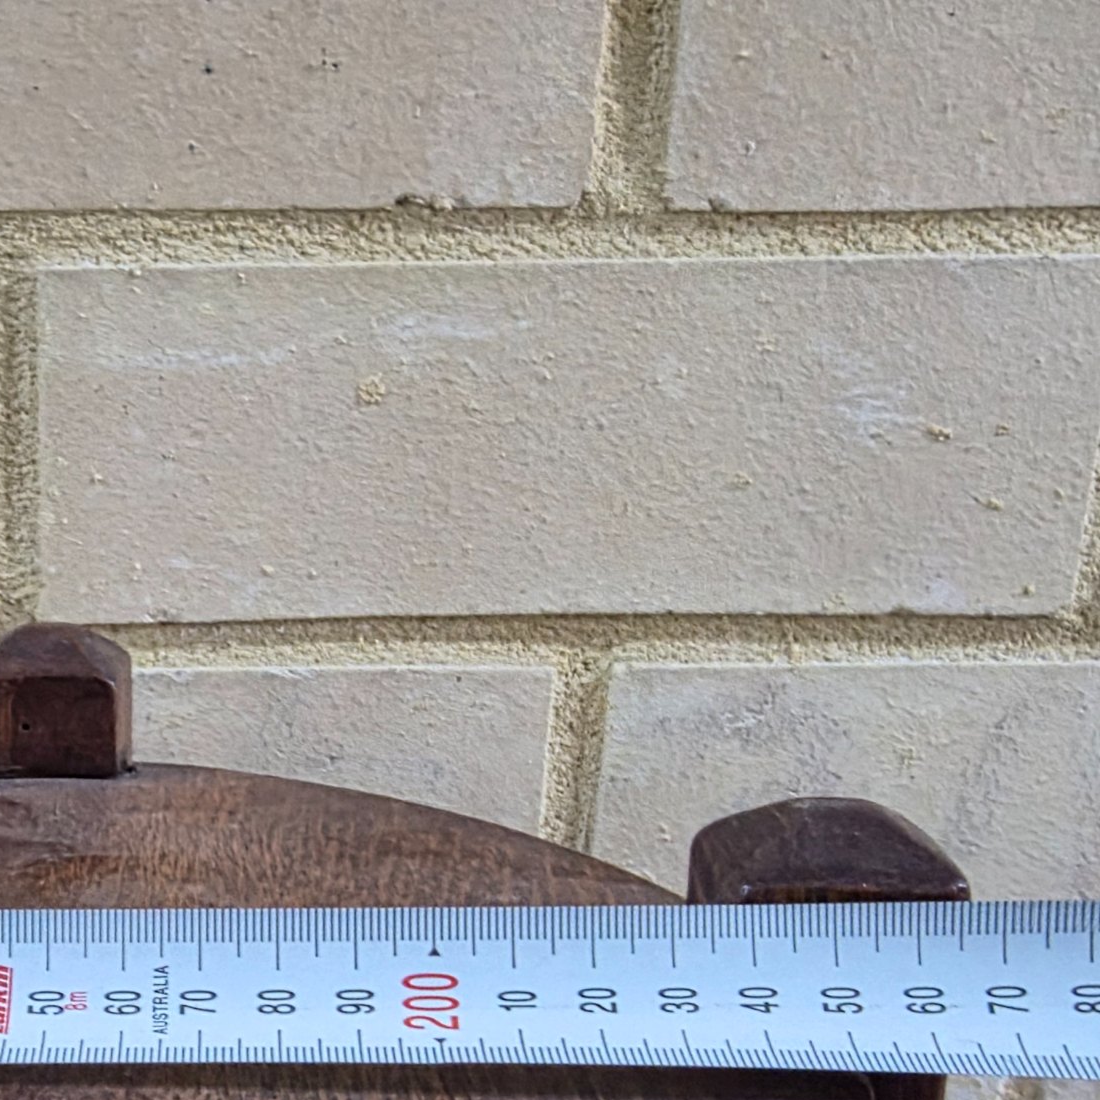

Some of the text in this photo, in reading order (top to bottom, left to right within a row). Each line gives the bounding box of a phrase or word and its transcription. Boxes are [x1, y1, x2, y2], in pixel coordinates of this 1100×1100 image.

[27, 991, 65, 1015] 50
[64, 992, 87, 1010] 8m
[104, 990, 142, 1015] 60
[152, 965, 169, 1034] AUSTRALIA
[179, 990, 218, 1015] 70
[257, 989, 296, 1014] 80
[336, 989, 375, 1014] 90
[401, 973, 460, 1030] 200
[497, 990, 537, 1011] 10
[577, 988, 618, 1013] 20
[660, 987, 699, 1013] 30
[738, 987, 779, 1013] 40
[820, 987, 861, 1014] 50
[903, 986, 946, 1014] 60
[986, 986, 1029, 1014] 70
[1071, 984, 1100, 1014] 80
